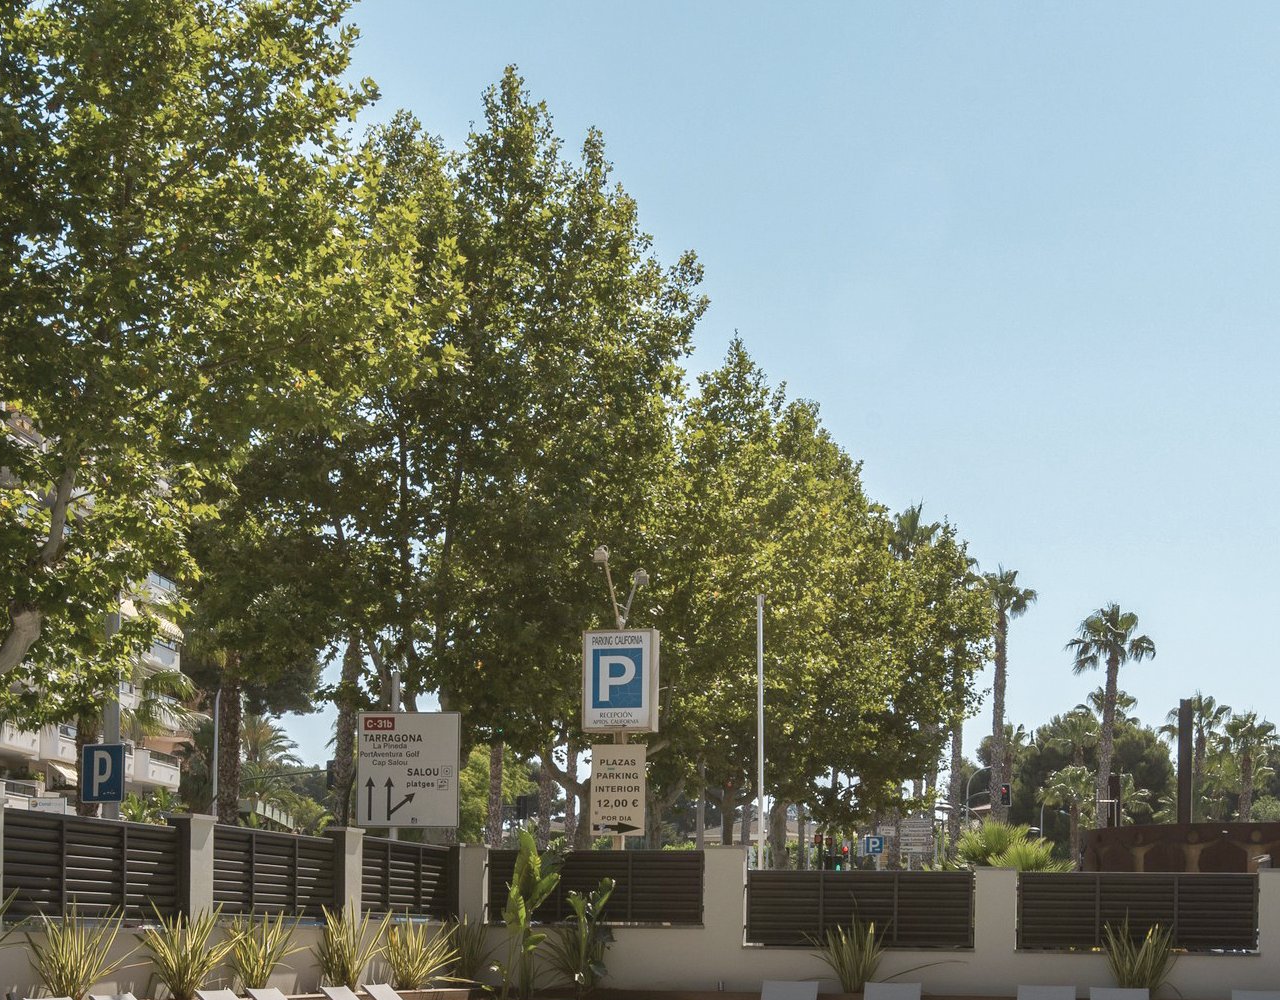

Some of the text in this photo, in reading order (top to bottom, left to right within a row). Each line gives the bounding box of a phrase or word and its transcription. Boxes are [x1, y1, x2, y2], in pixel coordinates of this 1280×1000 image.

[592, 634, 643, 646] PARKING CALIFORNIA
[599, 655, 636, 701] P
[366, 719, 393, 728] C-31b
[363, 733, 423, 742] TARRAGONA
[360, 750, 420, 758] PortAventura Golf
[372, 759, 386, 767] Cap
[600, 758, 636, 766] PLAZAS
[92, 750, 112, 797] P
[406, 767, 439, 776] SALOU
[596, 772, 639, 780] PARKING
[406, 780, 435, 789] platges
[595, 785, 640, 793] INTERIOR
[597, 799, 639, 809] 12,00 €
[869, 838, 880, 852] P
